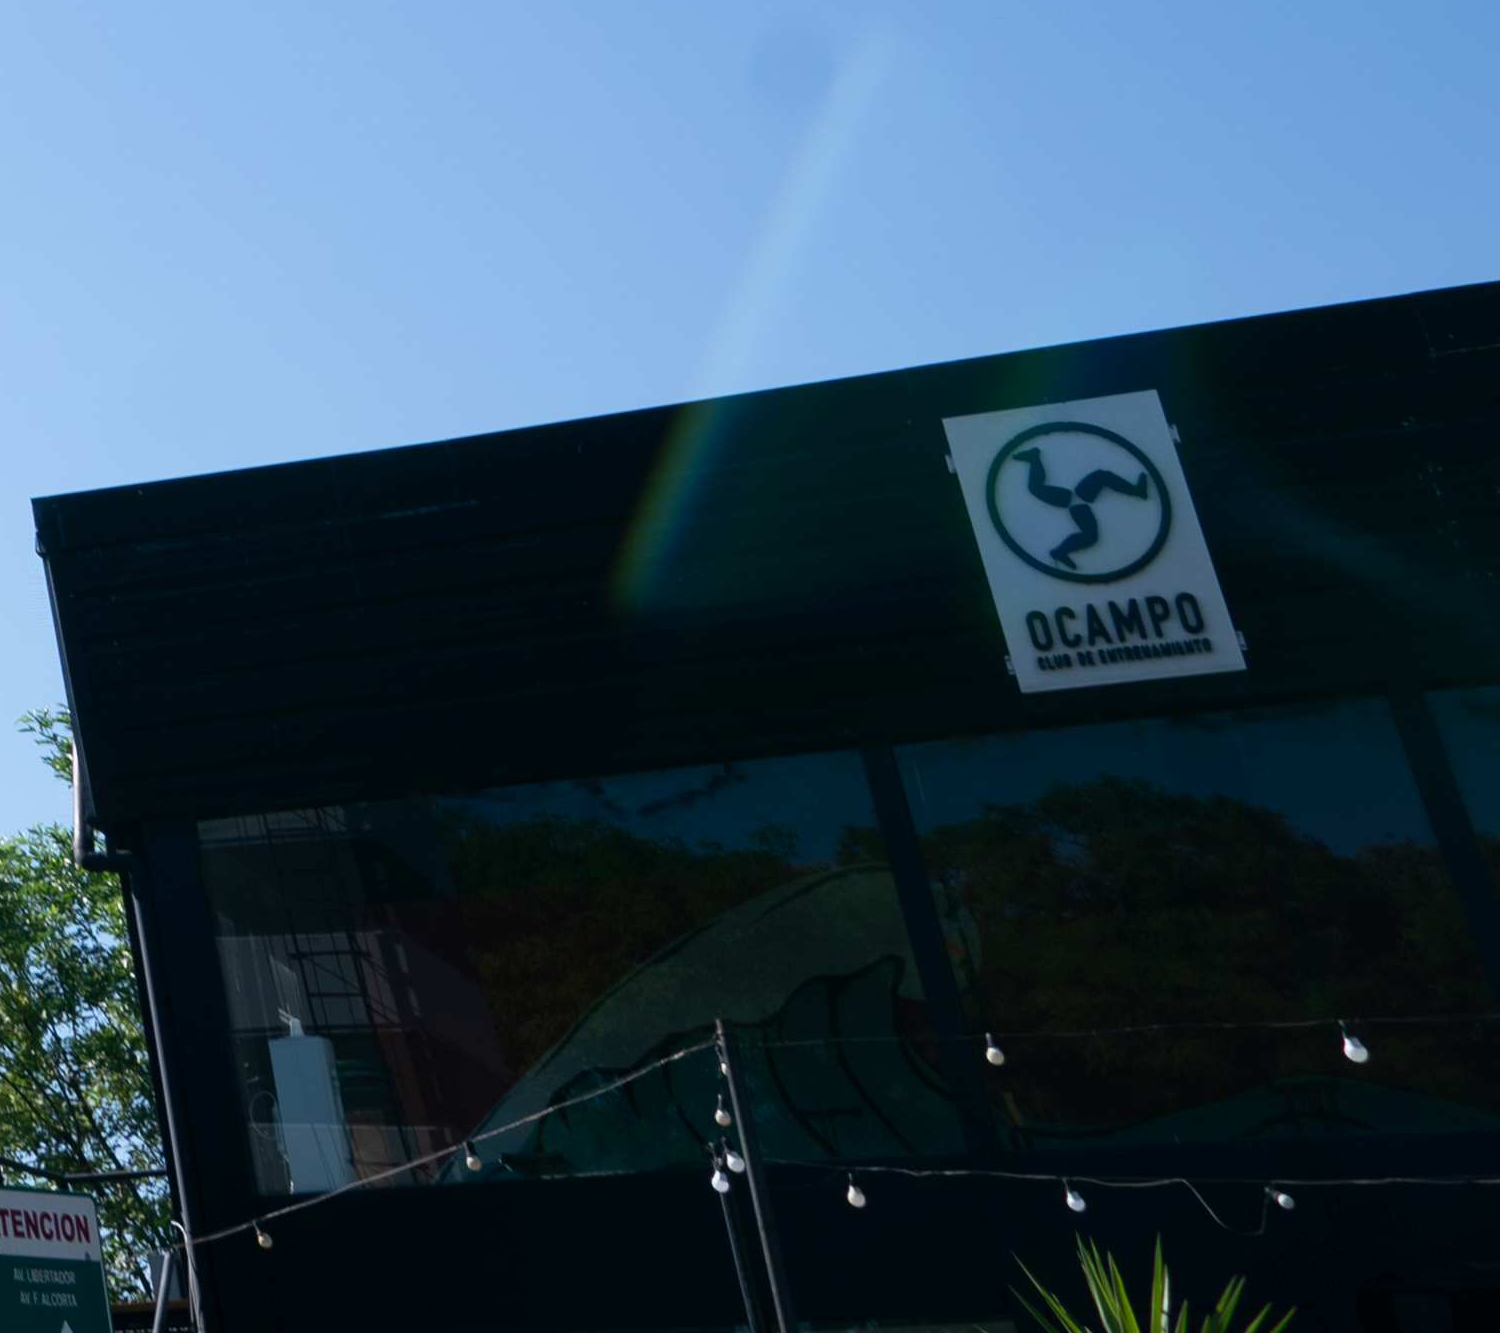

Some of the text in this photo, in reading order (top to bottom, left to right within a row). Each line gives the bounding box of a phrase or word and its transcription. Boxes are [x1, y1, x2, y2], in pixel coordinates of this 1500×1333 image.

[1026, 591, 1205, 652] OCAMPO
[1037, 637, 1213, 672] CLUB DE ENTRENAMIENTO
[26, 1268, 76, 1285] LIBERTADOR
